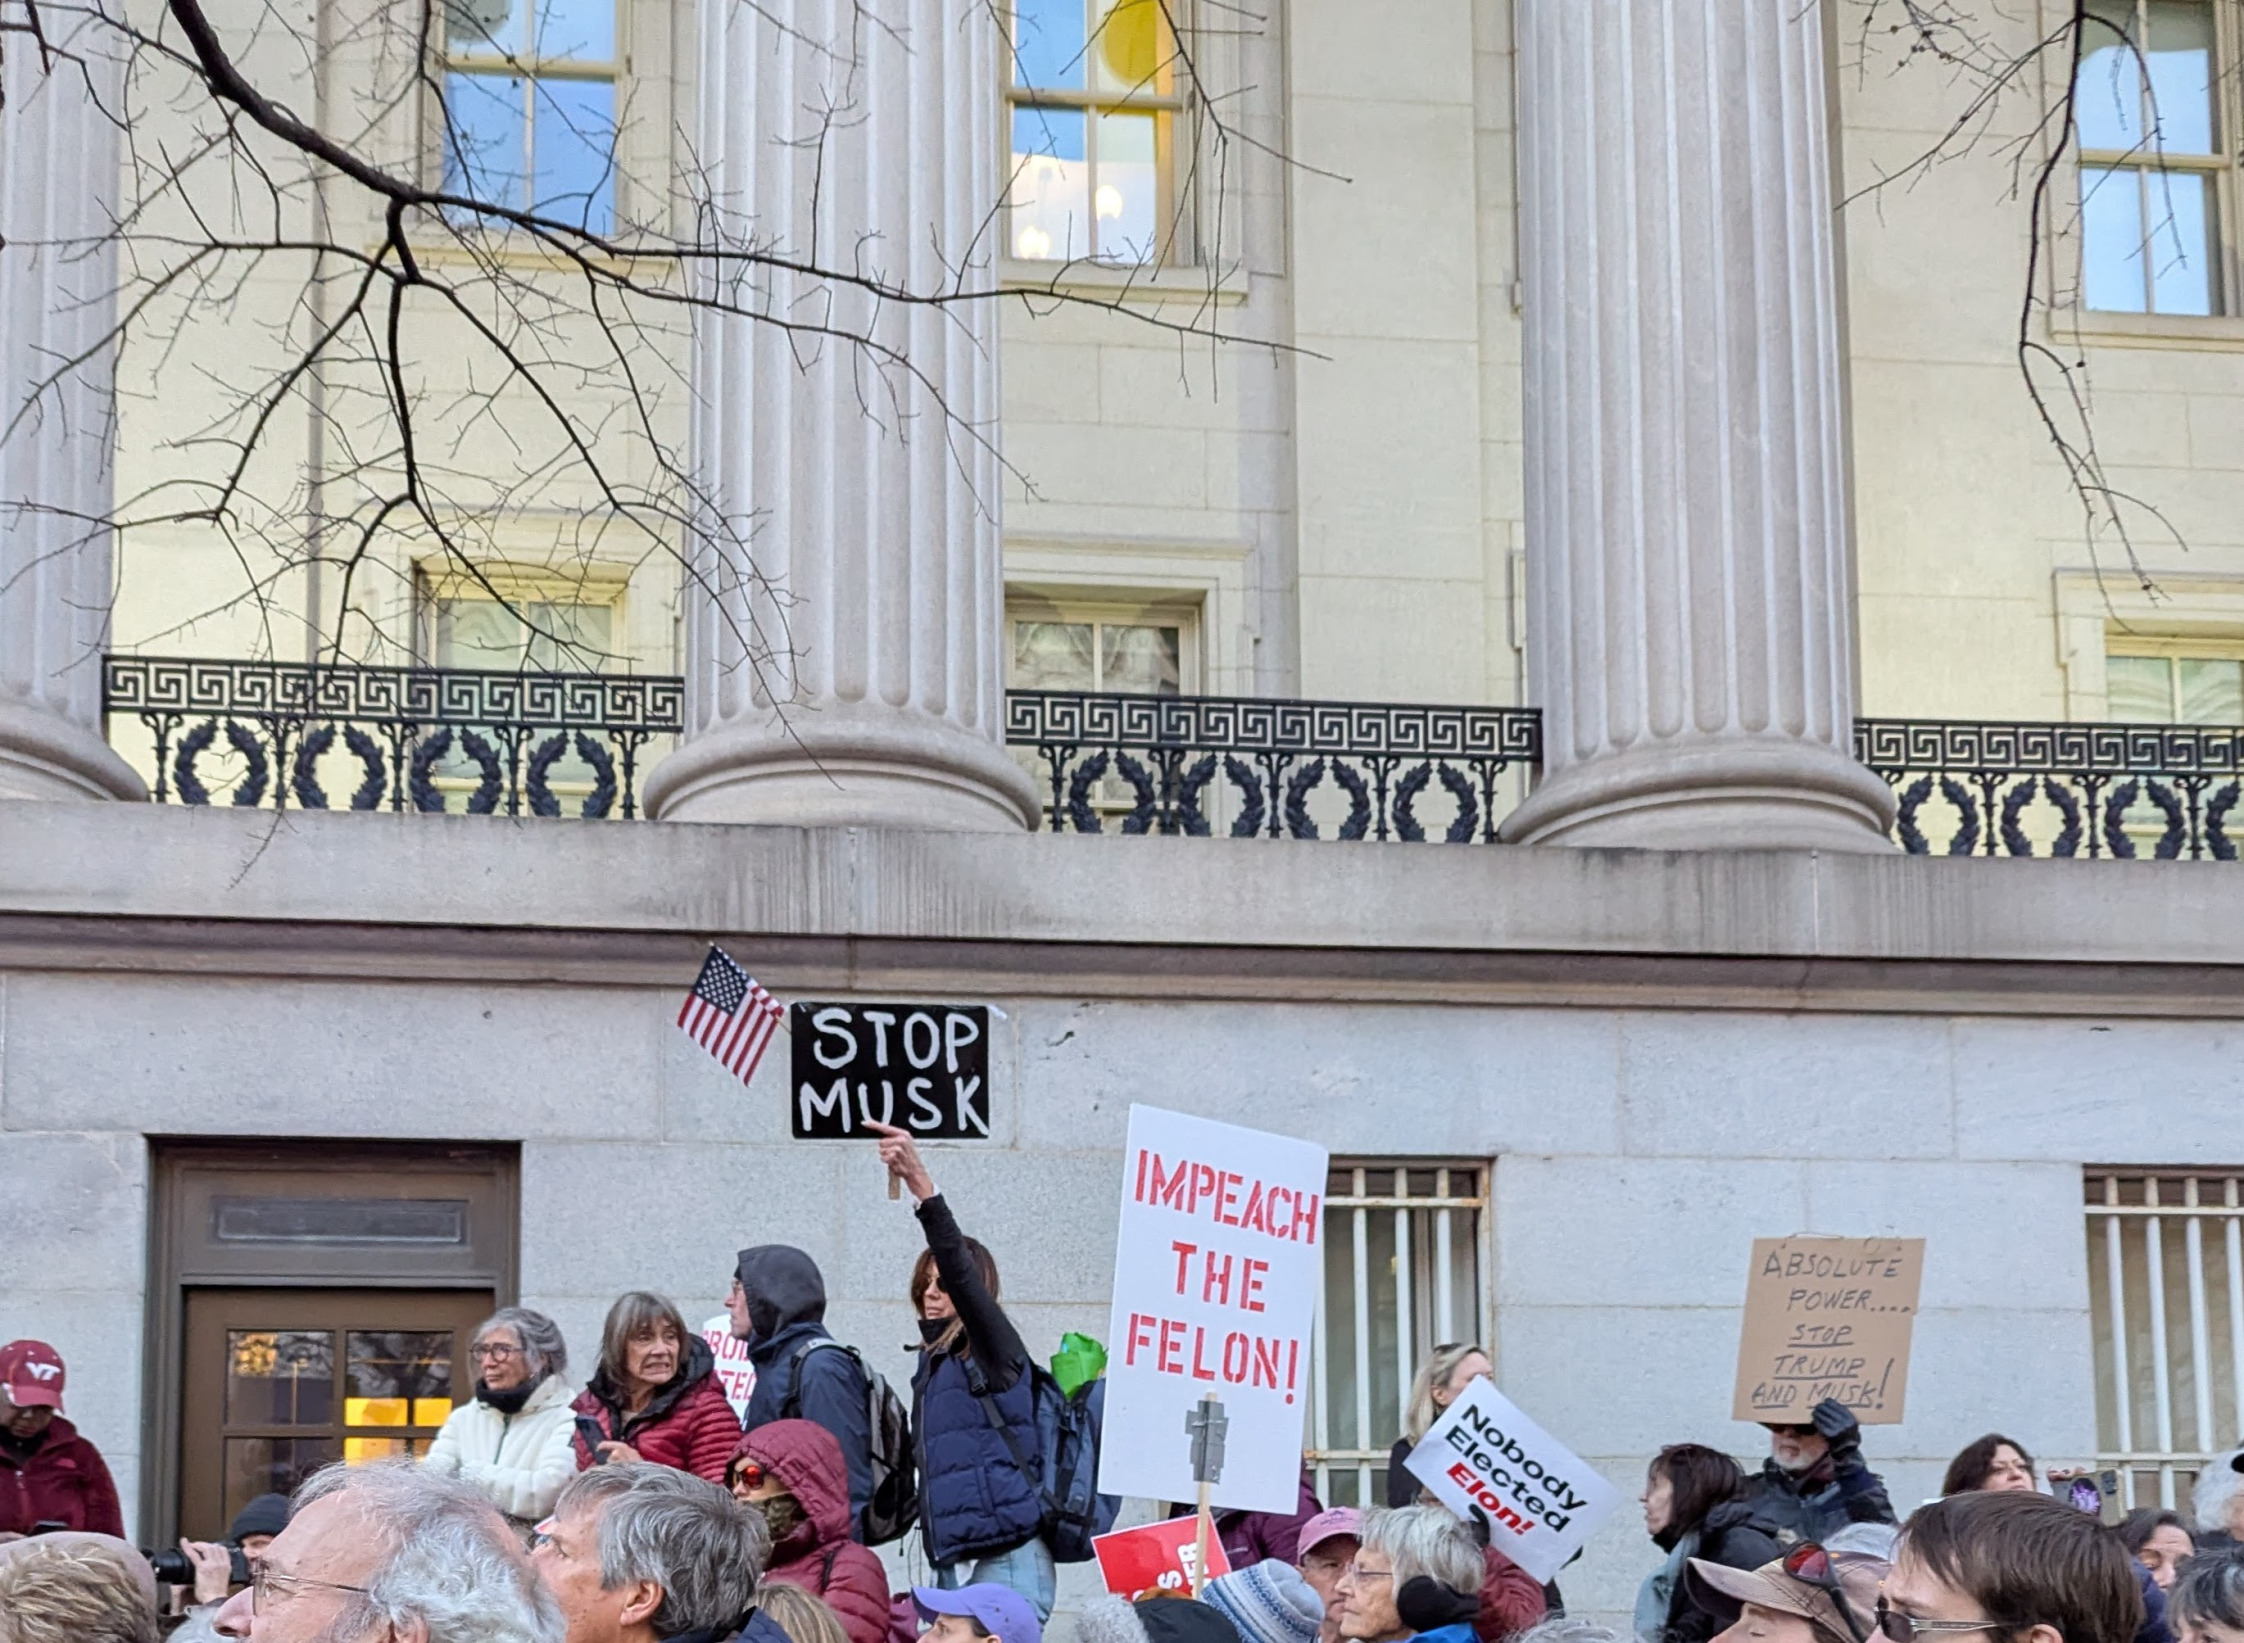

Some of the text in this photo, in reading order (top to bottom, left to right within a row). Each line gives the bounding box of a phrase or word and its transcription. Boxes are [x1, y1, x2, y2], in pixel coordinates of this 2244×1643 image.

[812, 1007, 980, 1073] STOP
[799, 1076, 989, 1136] MUSK
[1135, 1149, 1319, 1245] IMPEACH
[1172, 1240, 1270, 1313] THE
[1763, 1250, 1904, 1279] ABSOLUTE
[1125, 1313, 1299, 1405] FELON!
[1773, 1354, 1866, 1378] TRUMP
[1788, 1323, 1853, 1345] STOP
[25, 1361, 62, 1381] VT
[1751, 1357, 1896, 1410] AND MUSK!
[1444, 1425, 1572, 1533] Elected
[1460, 1403, 1589, 1511] Nobody
[1446, 1461, 1537, 1536] Elon!
